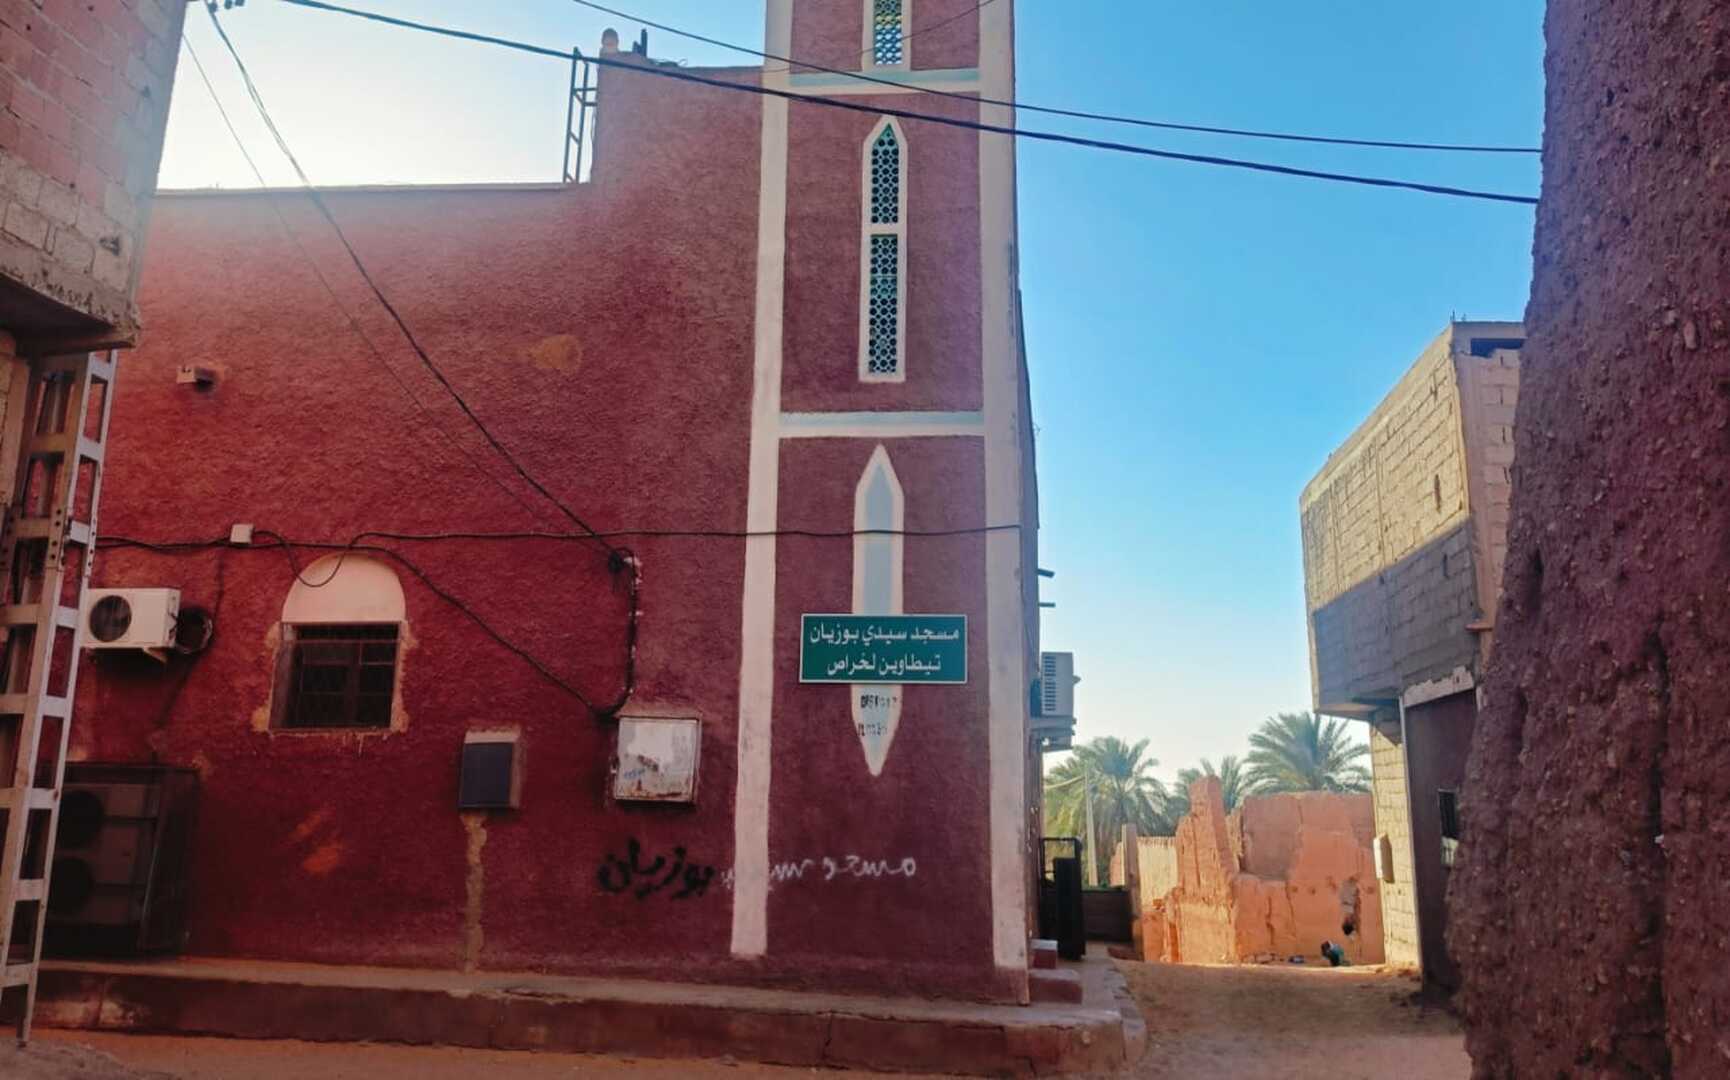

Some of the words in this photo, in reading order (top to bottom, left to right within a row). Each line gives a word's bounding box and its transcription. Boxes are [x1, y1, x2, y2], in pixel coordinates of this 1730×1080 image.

[809, 622, 860, 646] بوزيان
[862, 624, 907, 646] سيدي
[910, 626, 960, 645] مسجد
[826, 652, 876, 676] لخراص
[878, 653, 942, 676] تيطاوين
